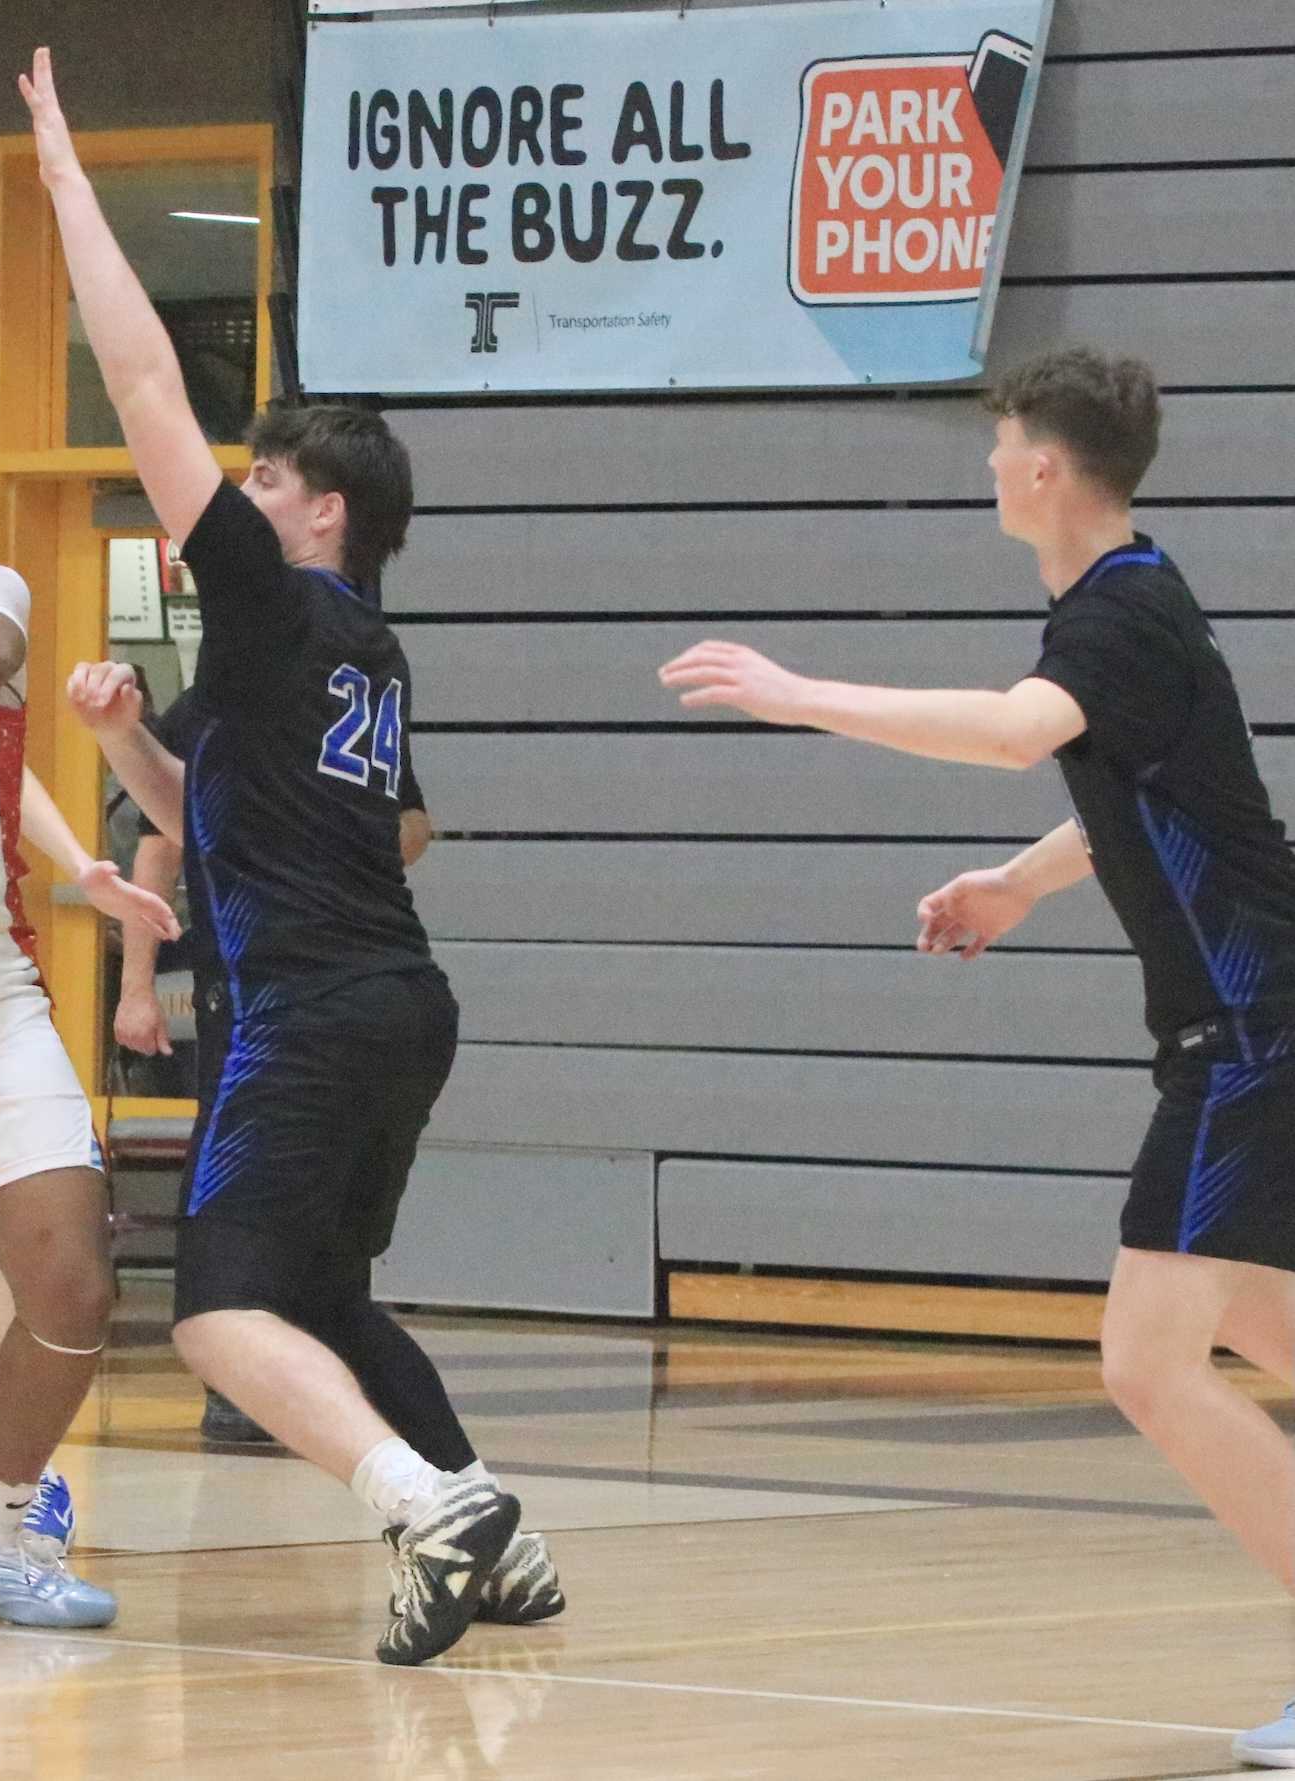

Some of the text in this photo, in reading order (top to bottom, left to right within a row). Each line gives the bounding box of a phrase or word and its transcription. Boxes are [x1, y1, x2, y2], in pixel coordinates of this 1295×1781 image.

[348, 78, 751, 170] IGNORE ALL
[819, 87, 964, 146] PARK
[816, 152, 973, 210] YOUR
[371, 178, 724, 267] THE BUZZ.
[549, 311, 672, 333] Transportation Safety
[317, 662, 402, 800] 24
